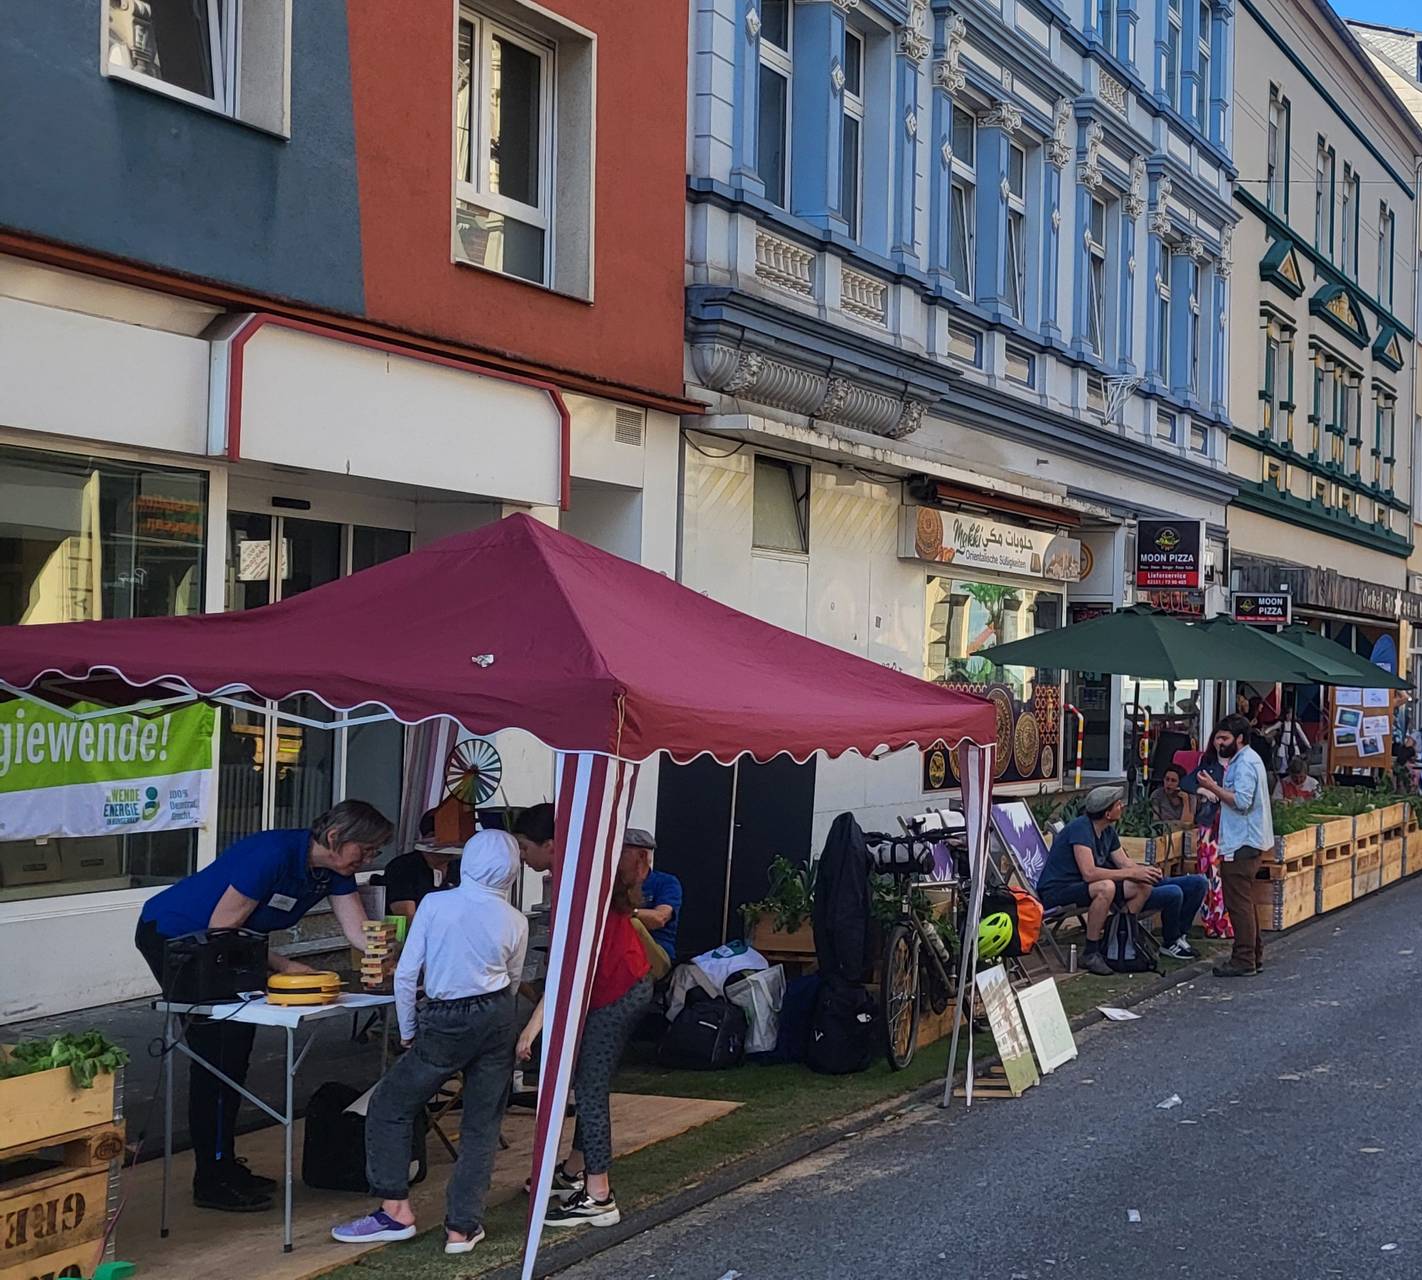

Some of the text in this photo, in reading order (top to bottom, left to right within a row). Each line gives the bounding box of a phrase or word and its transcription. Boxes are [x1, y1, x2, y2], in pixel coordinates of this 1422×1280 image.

[982, 528, 1034, 553] حلويات مكي
[965, 549, 1027, 571] Orientalische Süßigkeiten
[1140, 554, 1194, 562] MOON PIZZA
[1258, 597, 1283, 605] MOON
[1258, 606, 1283, 615] PIZZA
[0, 708, 172, 777] giewende!
[111, 788, 140, 801] WENDE
[103, 803, 140, 817] ENERGIE
